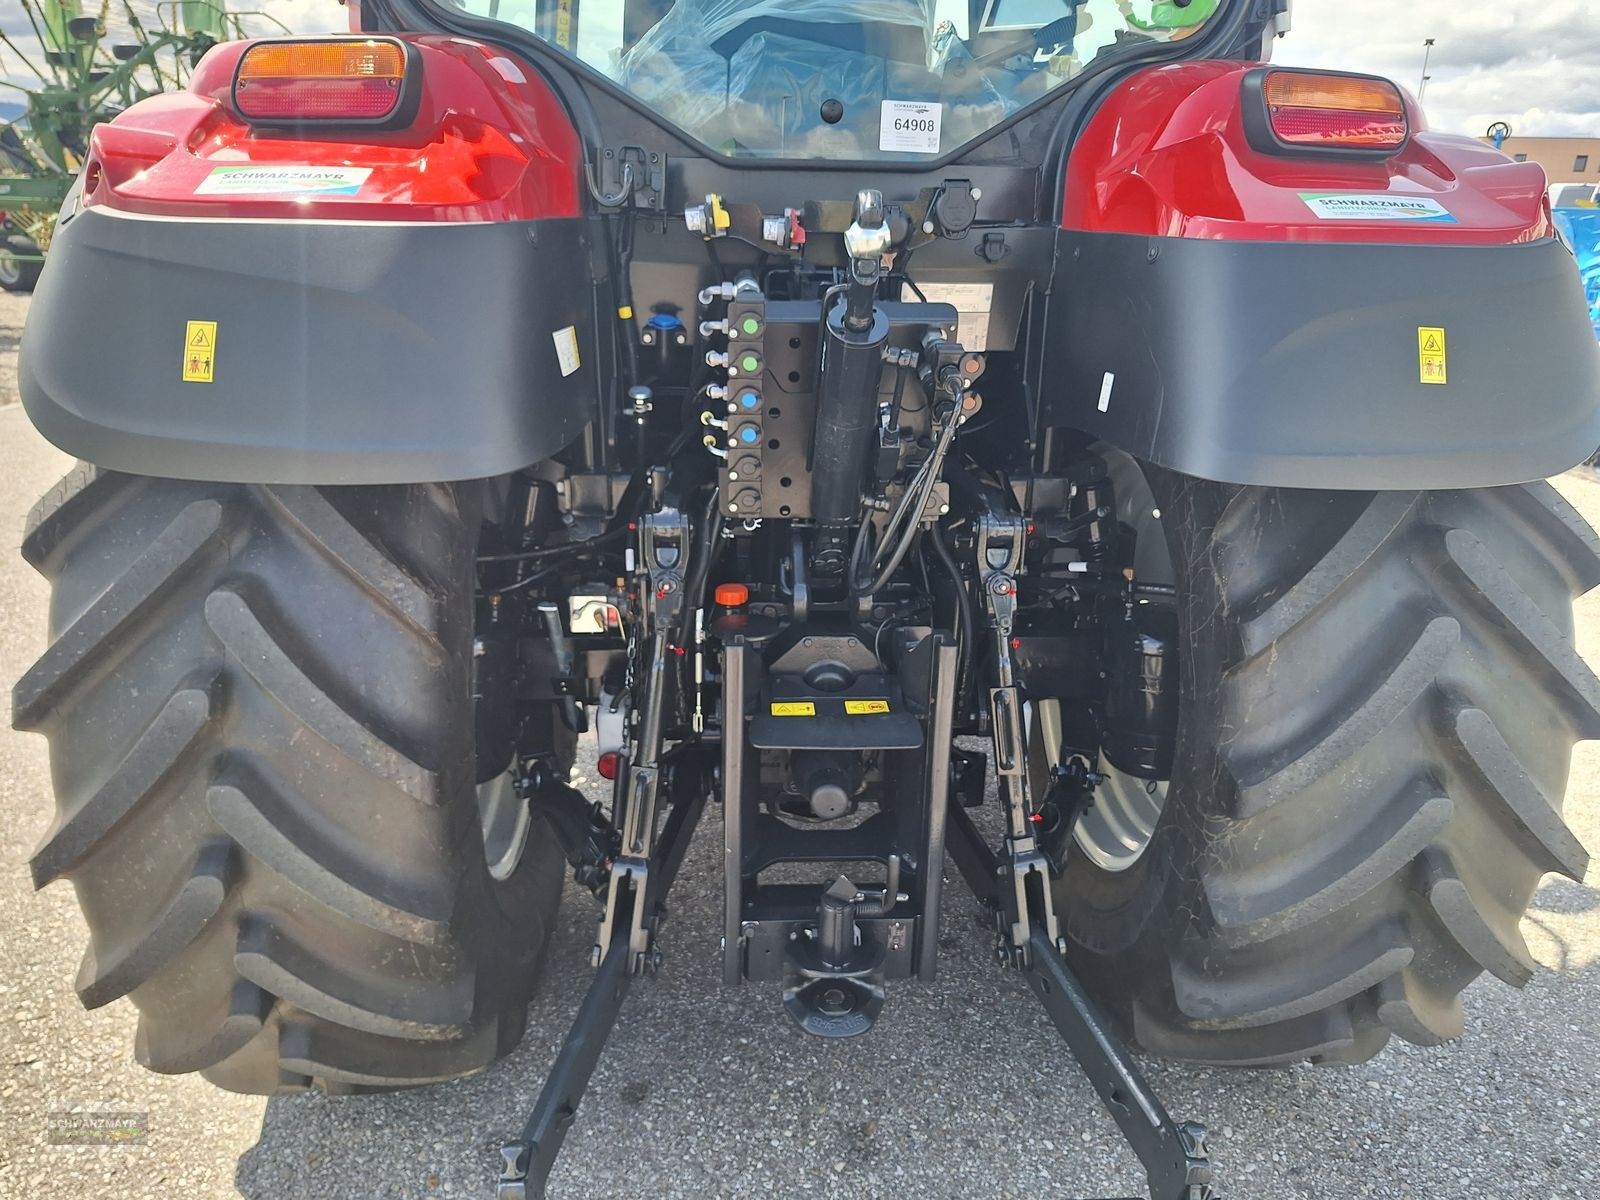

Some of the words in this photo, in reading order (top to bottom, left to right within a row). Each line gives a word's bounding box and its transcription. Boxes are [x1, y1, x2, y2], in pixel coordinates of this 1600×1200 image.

[894, 118, 935, 132] 64908
[221, 172, 345, 180] SCHWARZMAYR
[1318, 198, 1426, 209] SCHWARZMAYR
